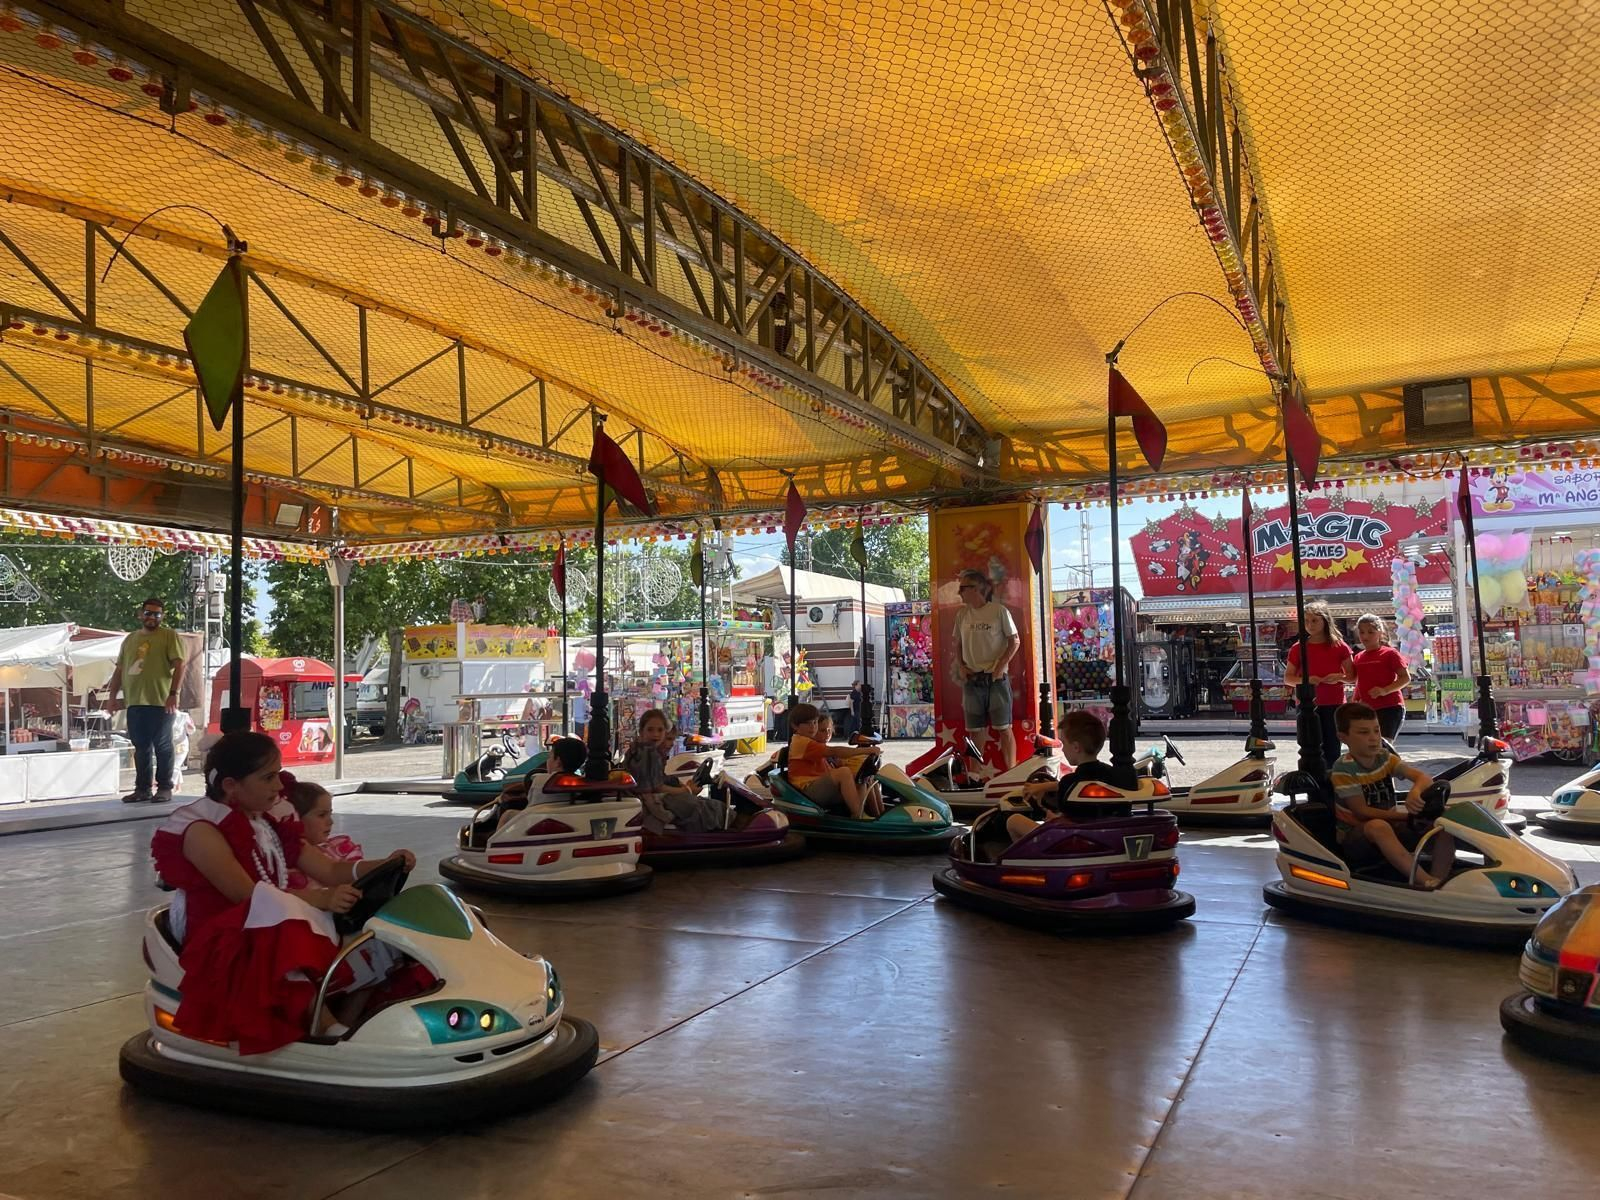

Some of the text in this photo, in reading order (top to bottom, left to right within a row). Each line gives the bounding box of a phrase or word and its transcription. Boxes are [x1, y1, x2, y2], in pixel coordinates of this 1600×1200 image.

[1253, 512, 1391, 555] MAGIC
[1298, 544, 1344, 558] GAMES
[601, 821, 608, 837] 3
[1135, 839, 1144, 857] 7
